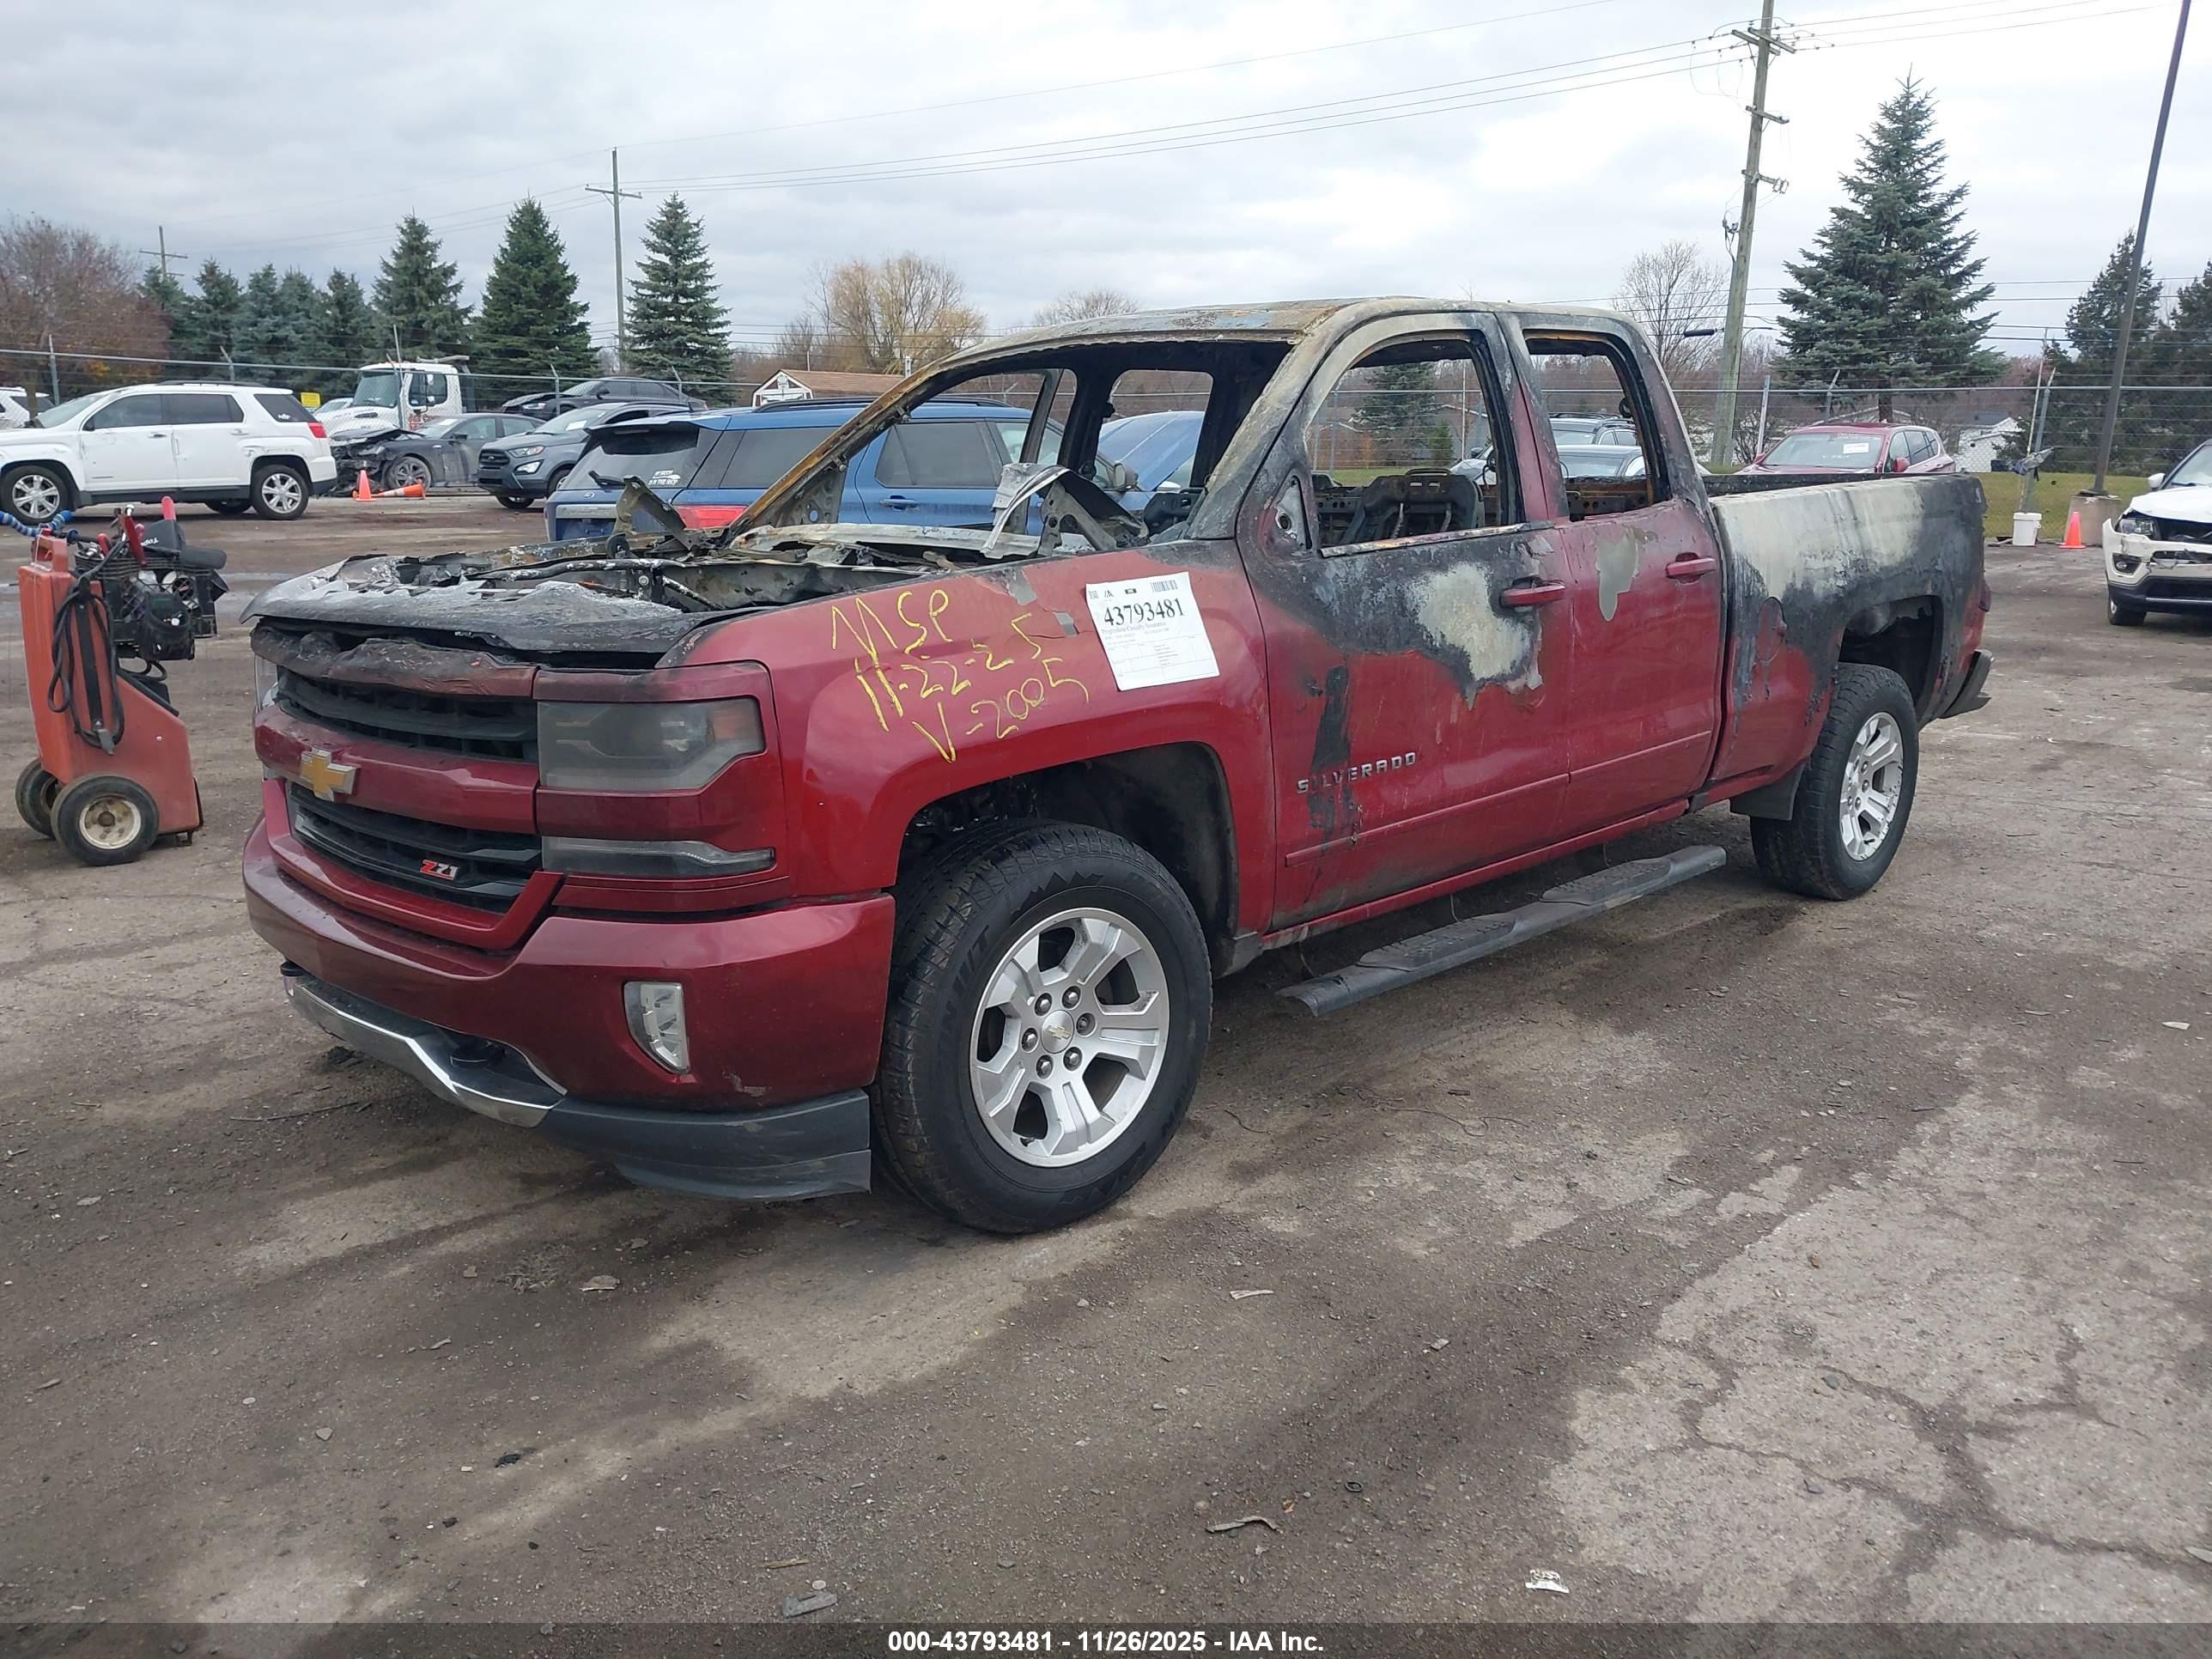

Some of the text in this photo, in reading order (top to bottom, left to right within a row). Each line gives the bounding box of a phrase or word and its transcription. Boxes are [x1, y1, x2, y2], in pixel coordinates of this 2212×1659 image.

[831, 589, 953, 663] MSP
[1104, 598, 1184, 626] 43793481
[1297, 751, 1417, 794] SILVERADO
[419, 859, 459, 880] Z71
